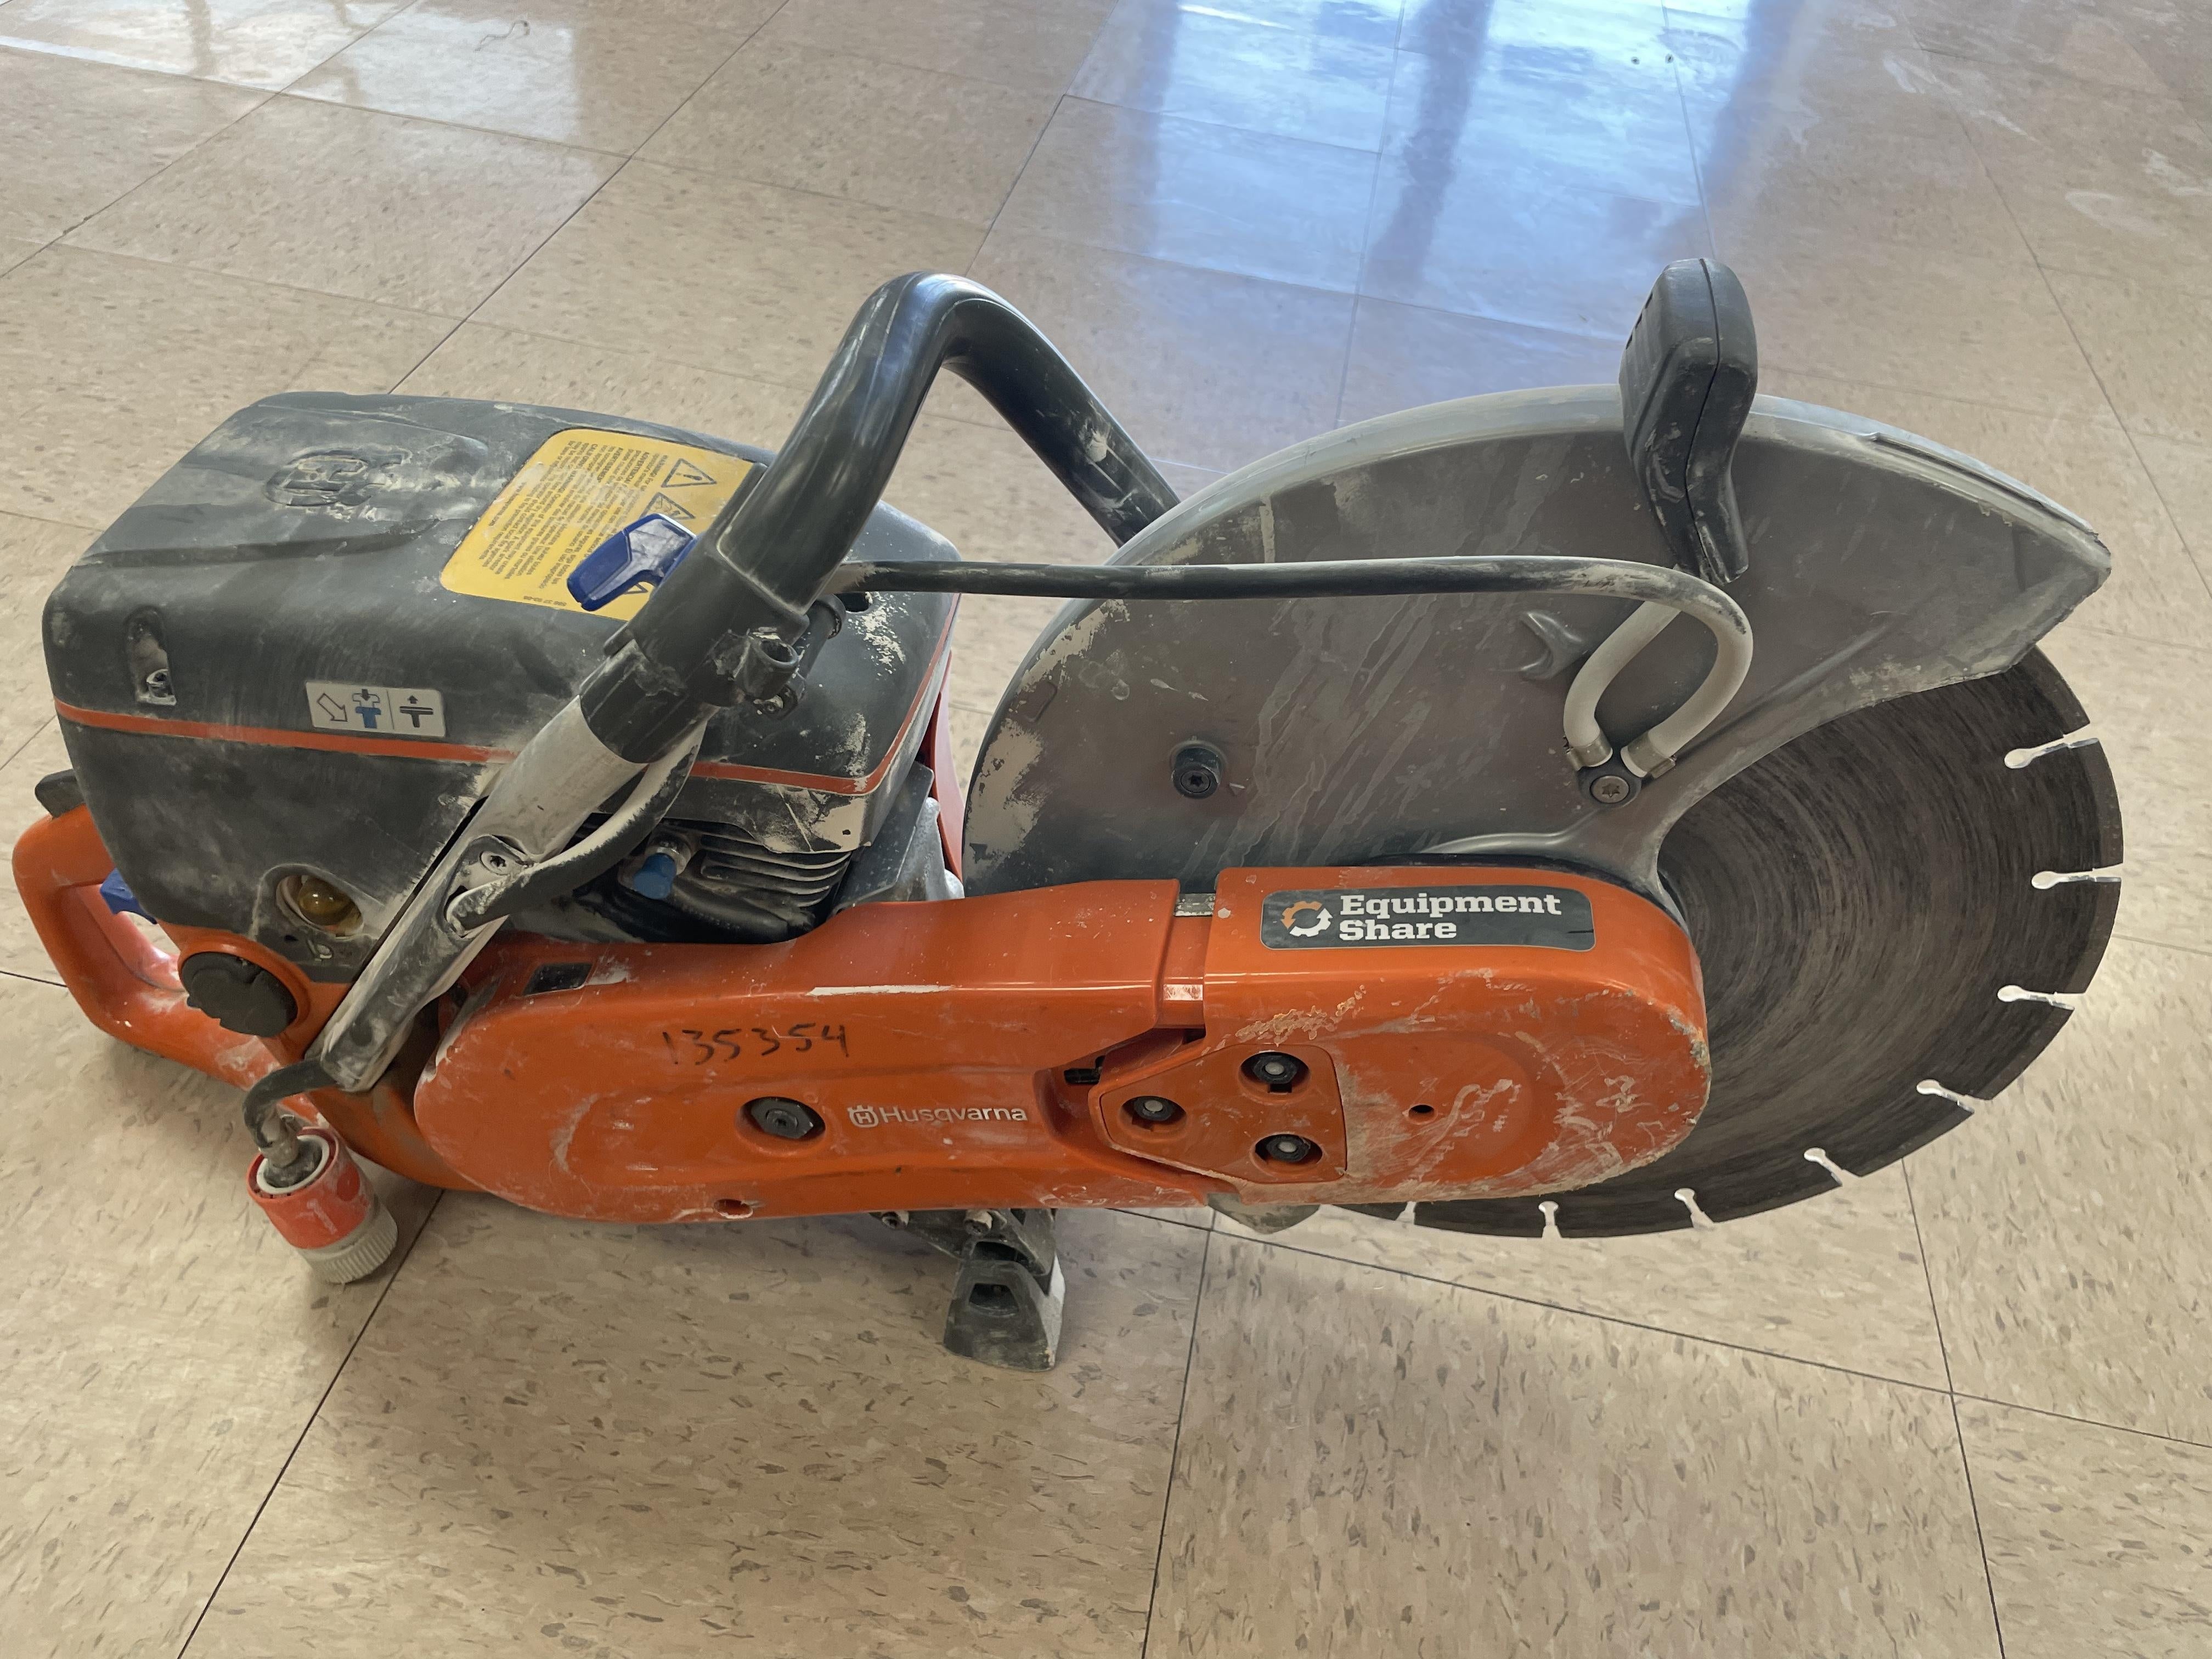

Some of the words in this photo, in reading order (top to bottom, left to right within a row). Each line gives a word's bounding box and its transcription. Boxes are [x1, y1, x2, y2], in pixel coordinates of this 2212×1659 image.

[1340, 893, 1562, 919] Equipment
[1339, 919, 1457, 941] Share
[662, 1022, 849, 1065] 135354
[879, 1105, 1028, 1124] Husqvarna
